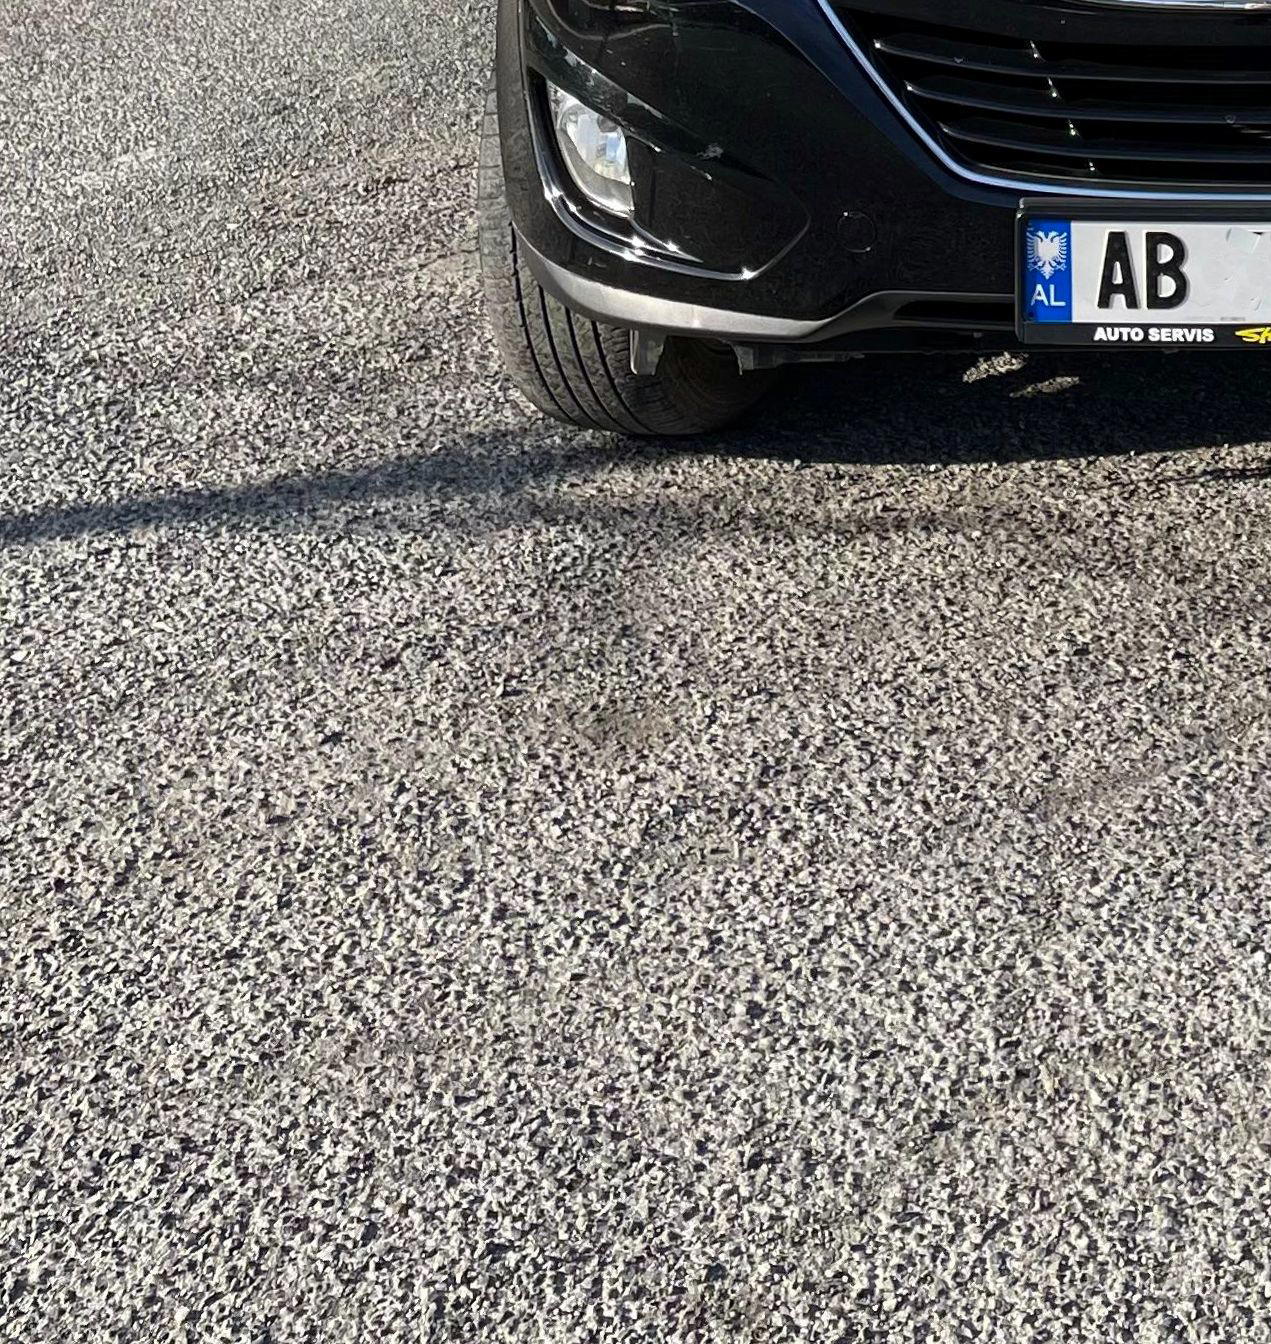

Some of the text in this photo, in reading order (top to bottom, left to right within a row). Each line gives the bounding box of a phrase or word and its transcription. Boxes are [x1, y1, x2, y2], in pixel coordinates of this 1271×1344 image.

[1097, 230, 1189, 310] AB
[1030, 283, 1067, 307] AL
[1093, 326, 1144, 342] AUTO
[1147, 326, 1215, 343] SERVIS
